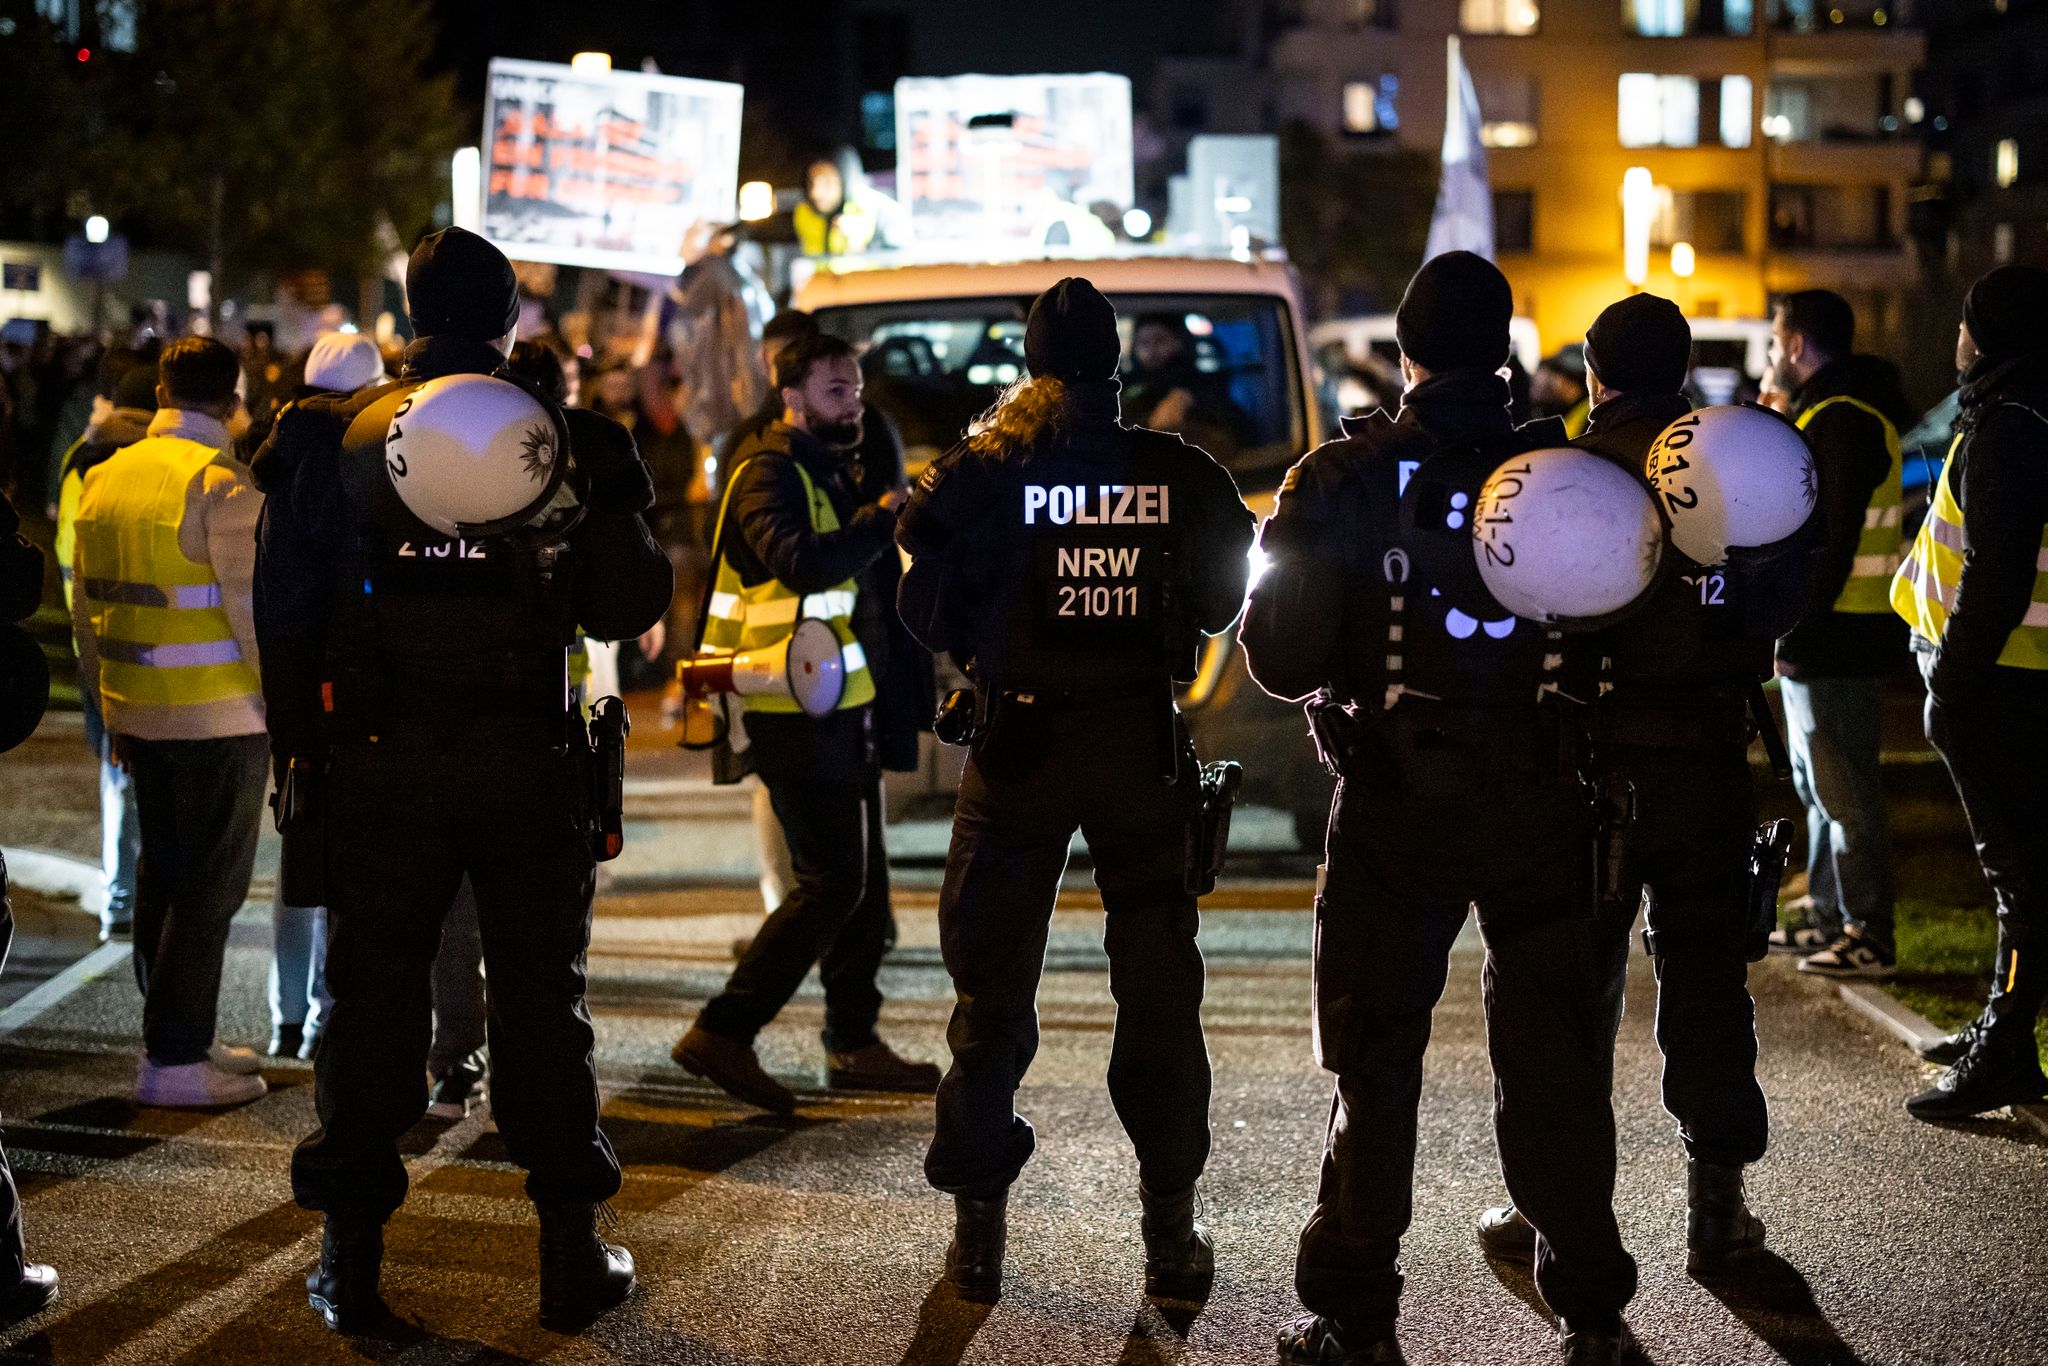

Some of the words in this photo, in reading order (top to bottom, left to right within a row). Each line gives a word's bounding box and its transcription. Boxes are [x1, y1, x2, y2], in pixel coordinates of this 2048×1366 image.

[1649, 439, 1662, 492] NRW
[1661, 415, 1701, 514] 10-1-2
[1025, 485, 1169, 525] POLIZEI
[1484, 463, 1532, 567] 10-1-2
[1057, 547, 1140, 577] NRW
[1058, 585, 1137, 617] 21011
